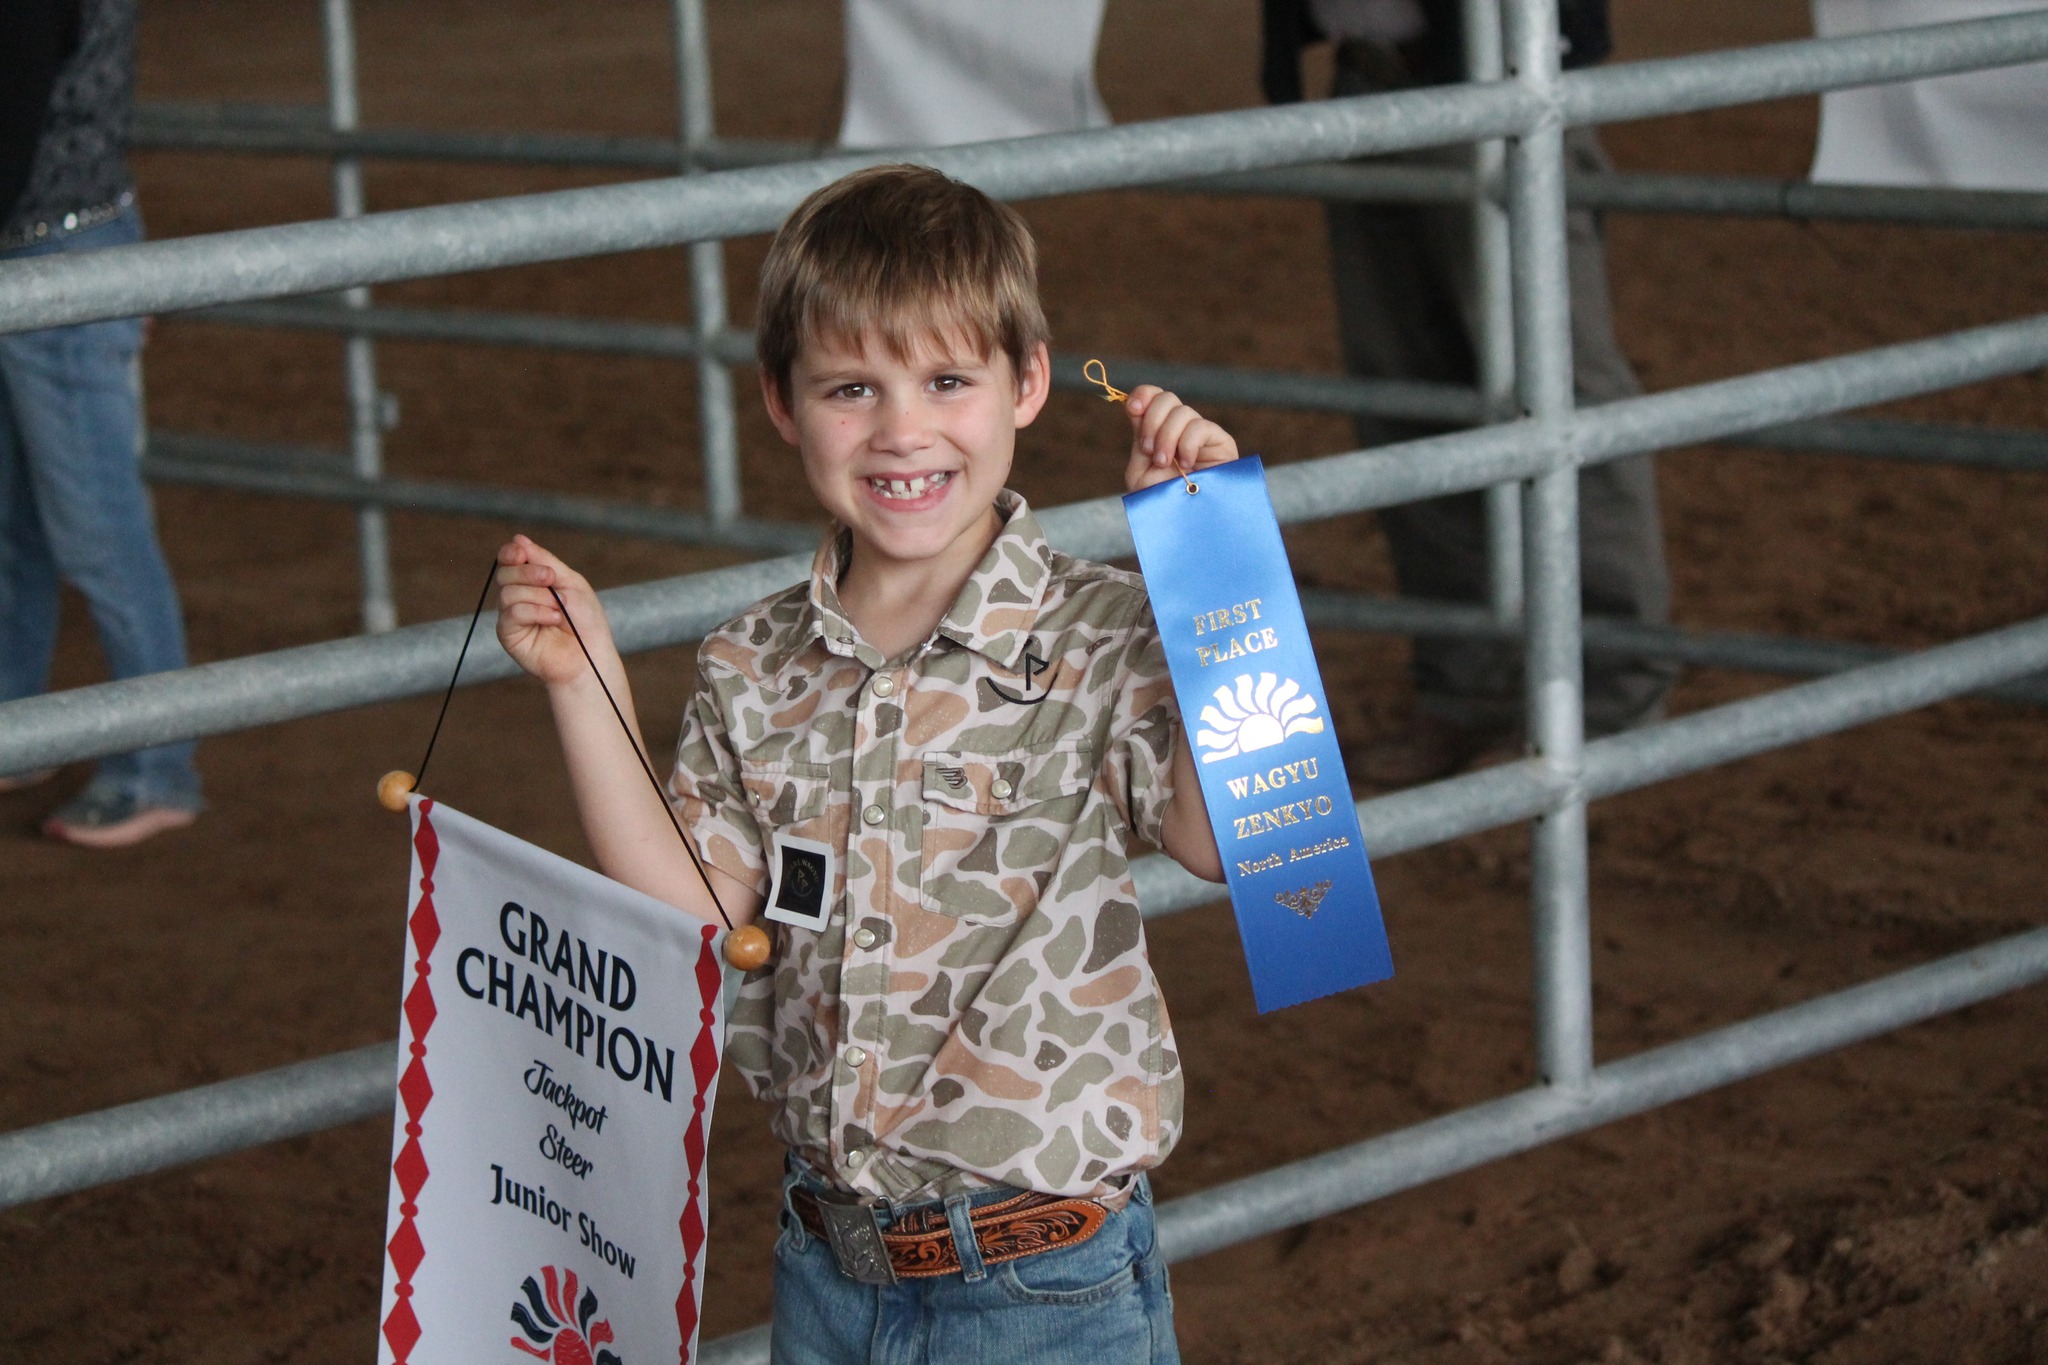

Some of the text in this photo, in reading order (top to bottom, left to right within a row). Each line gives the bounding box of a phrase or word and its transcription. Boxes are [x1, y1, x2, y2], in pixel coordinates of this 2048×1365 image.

[1193, 598, 1262, 636] FIRST
[1195, 627, 1278, 667] PLACE
[1226, 757, 1319, 800] WAGYU
[1233, 795, 1332, 840] ZENKYO
[1237, 836, 1350, 877] North America
[499, 901, 637, 1012] GRAND
[456, 947, 675, 1103] CHAMPION
[523, 1059, 609, 1135] Jackpot
[539, 1124, 594, 1181] Steer
[490, 1163, 636, 1280] Junior Show
